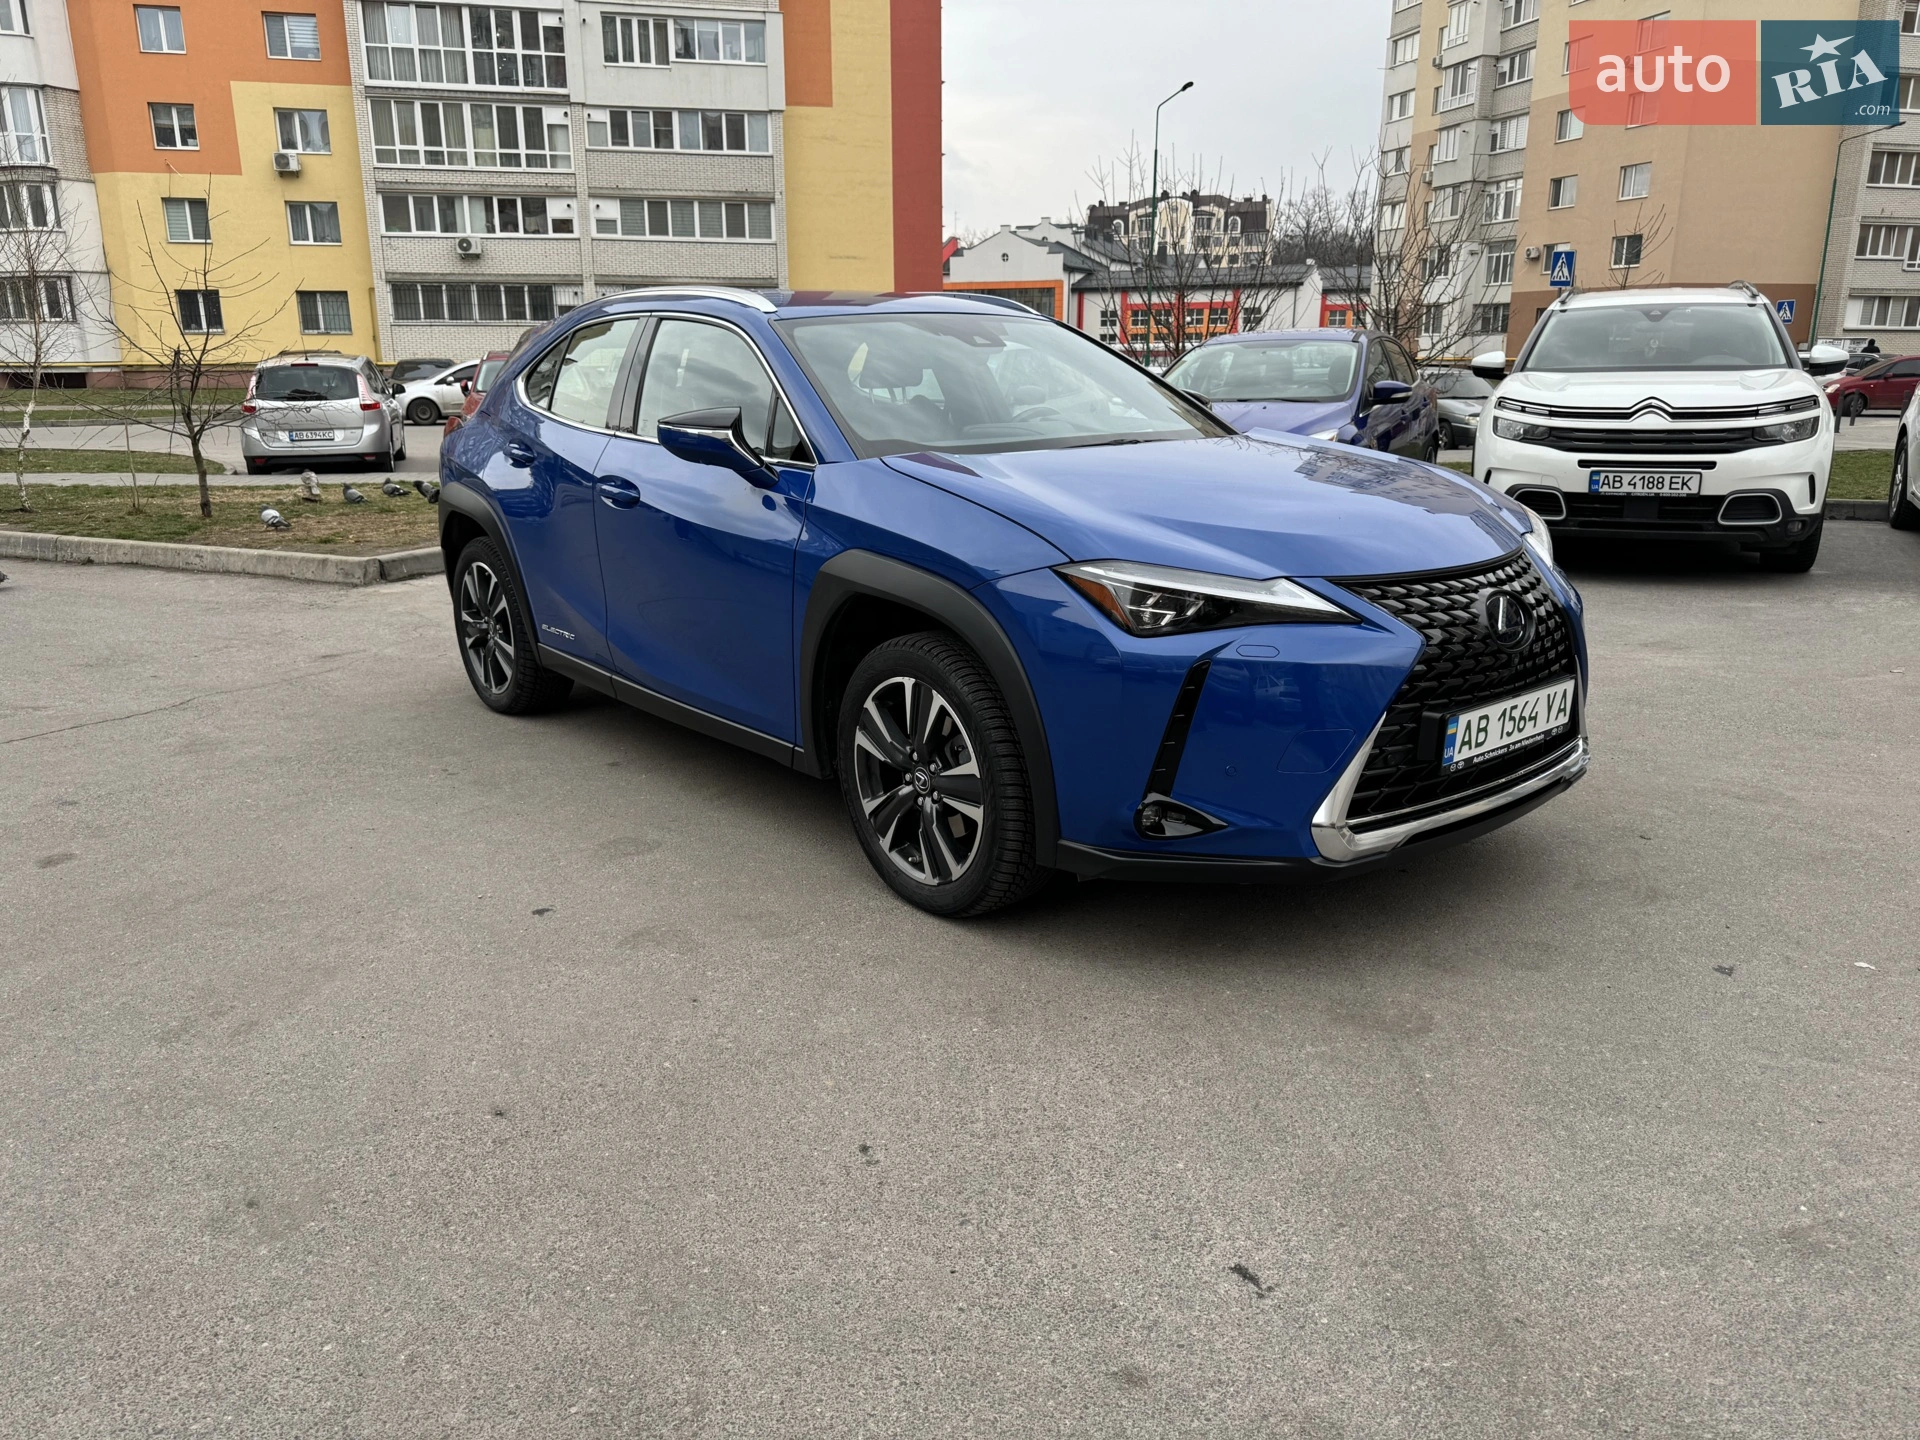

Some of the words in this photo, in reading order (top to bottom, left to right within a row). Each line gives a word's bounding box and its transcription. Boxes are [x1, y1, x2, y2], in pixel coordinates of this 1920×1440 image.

[1600, 474, 1624, 490] AB
[1627, 475, 1666, 491] 4188
[1668, 475, 1694, 491] EK
[1457, 713, 1491, 755] AB
[1497, 696, 1541, 740] 1564
[1545, 688, 1568, 724] YA
[1443, 746, 1455, 759] UA
